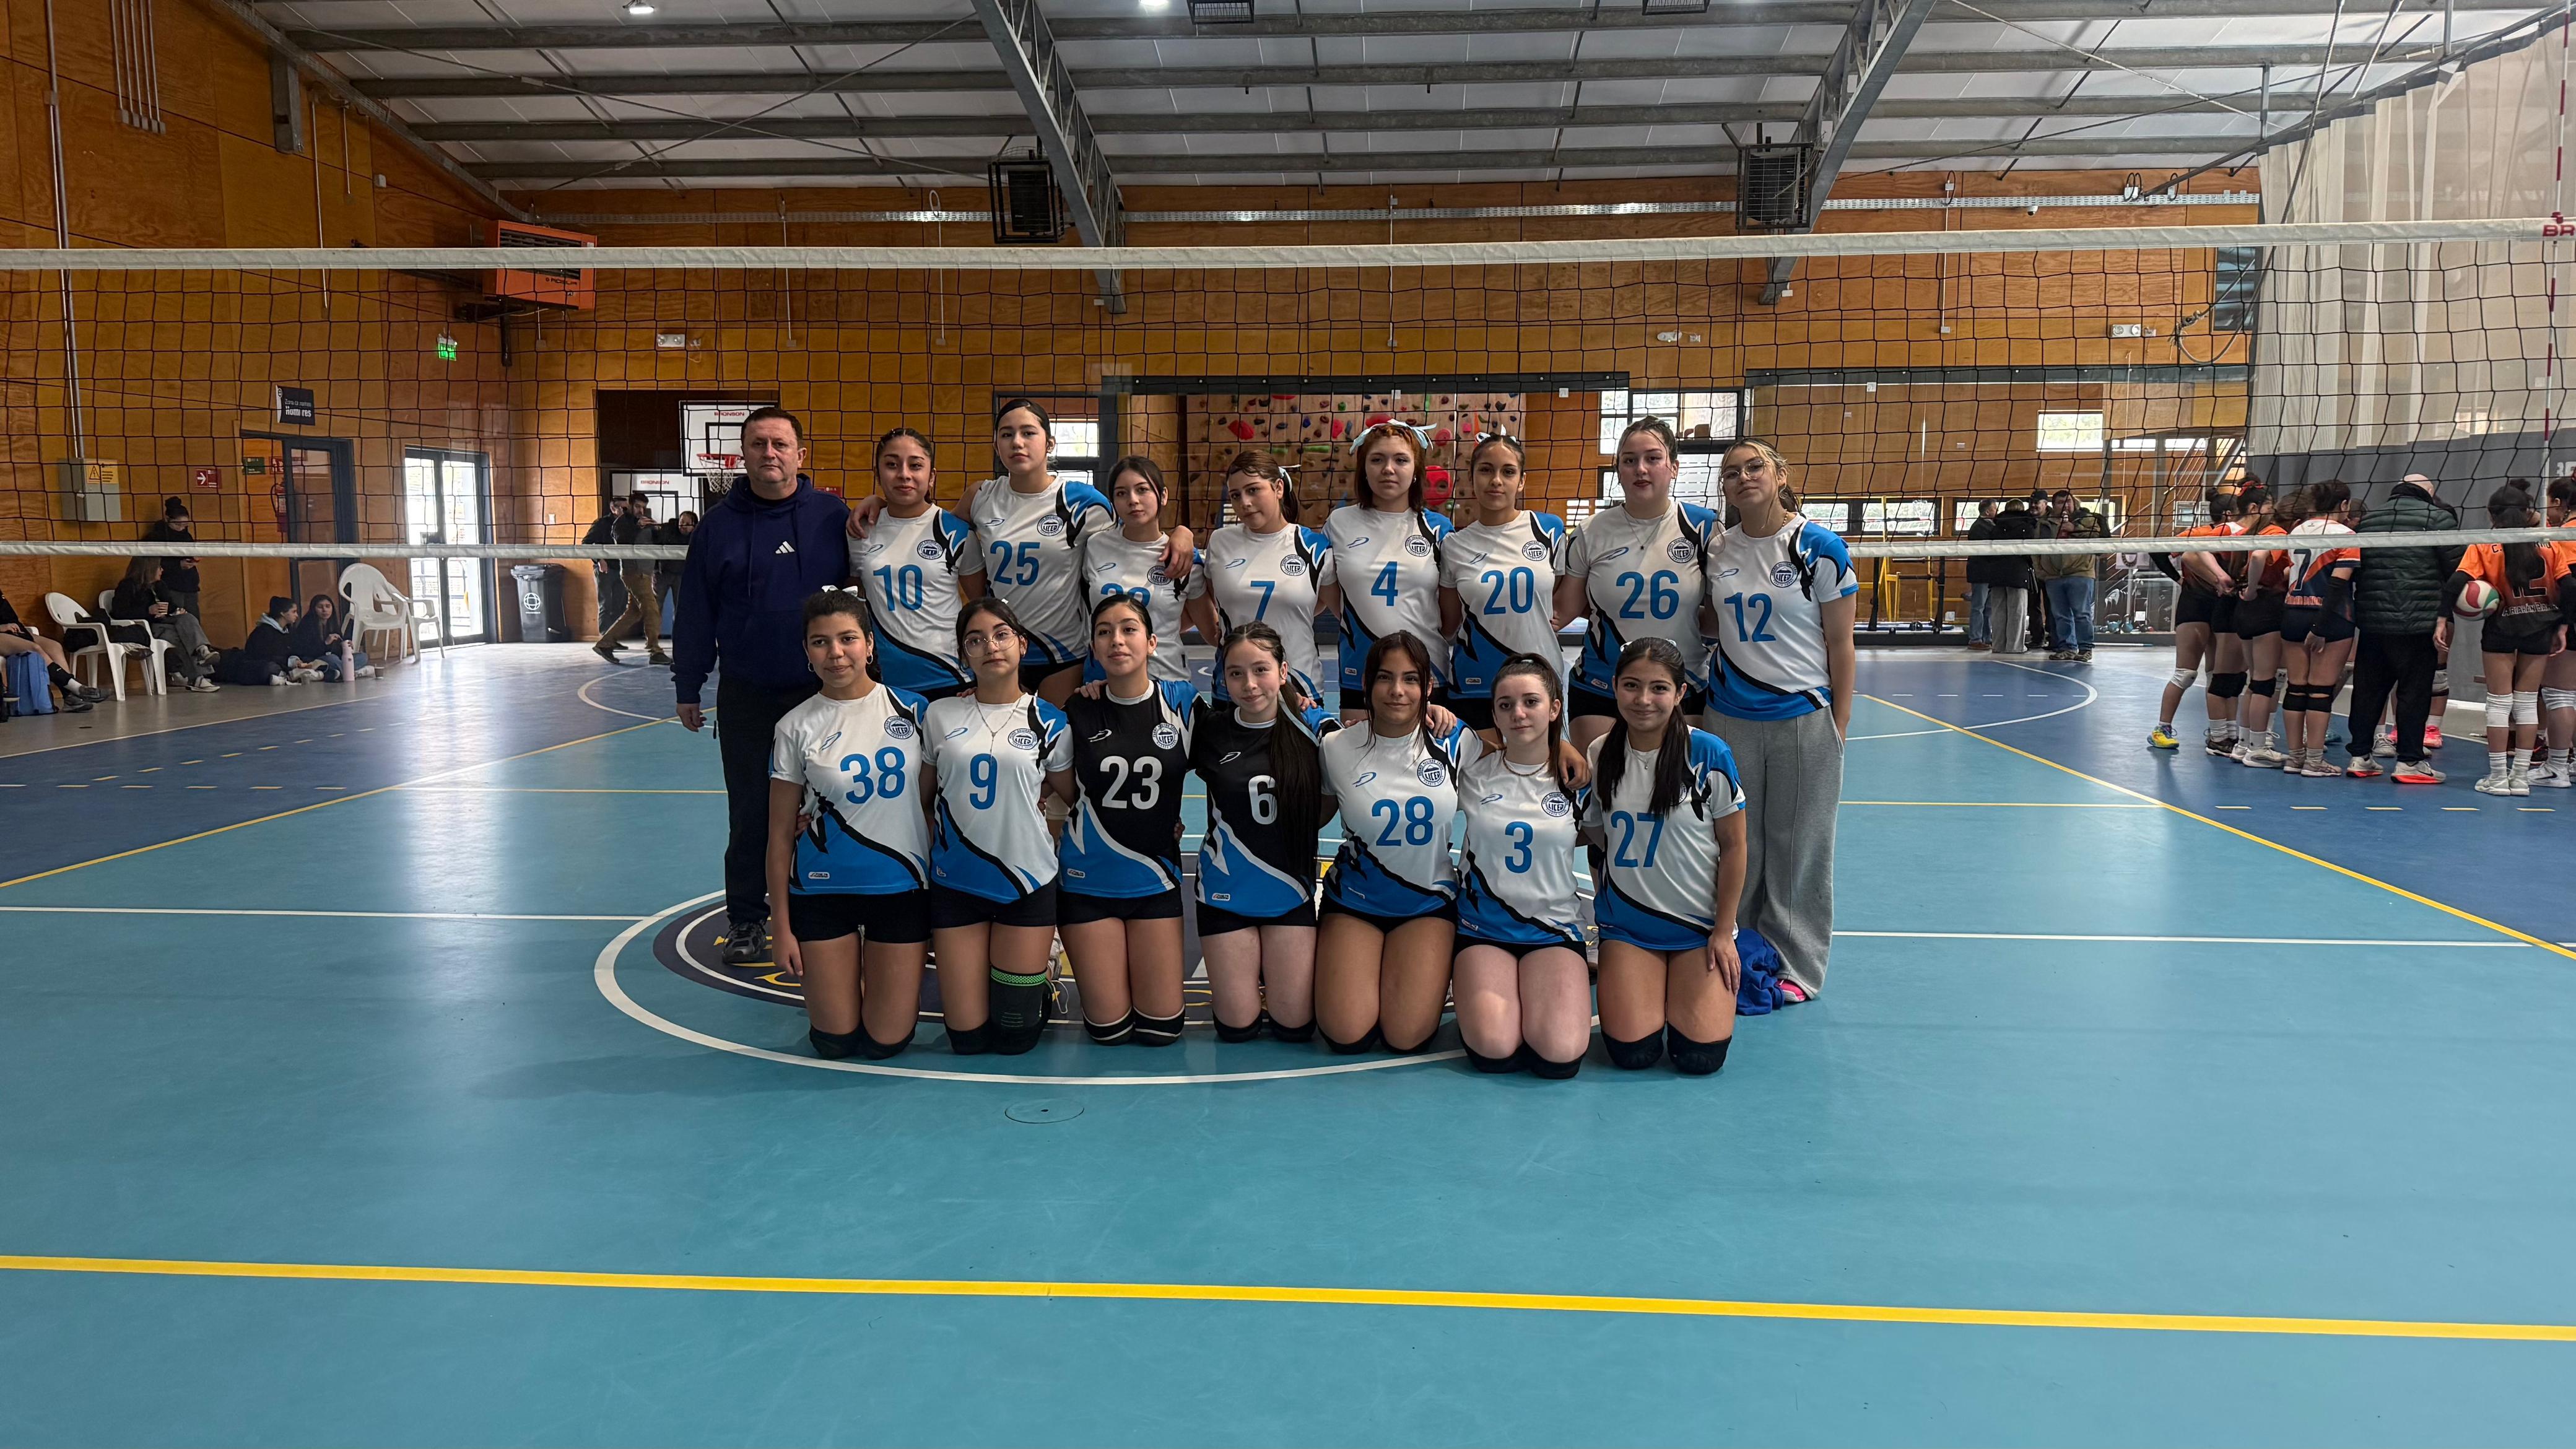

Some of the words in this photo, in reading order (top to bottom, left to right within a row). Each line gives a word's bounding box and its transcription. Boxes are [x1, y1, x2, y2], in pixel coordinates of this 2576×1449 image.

[873, 564, 923, 611] 10
[991, 541, 1040, 586] 25
[1371, 561, 1399, 606] 4
[2294, 549, 2312, 591] 7
[1250, 581, 1275, 622] 7
[1481, 566, 1534, 615] 20
[1616, 570, 1679, 619] 26
[1724, 592, 1776, 642] 12
[840, 747, 905, 804] 38
[970, 754, 998, 810] 9
[1100, 755, 1163, 809] 23
[1248, 775, 1277, 825] 6
[1372, 796, 1435, 846] 28
[1611, 811, 1664, 868] 27
[1505, 821, 1533, 874] 3
